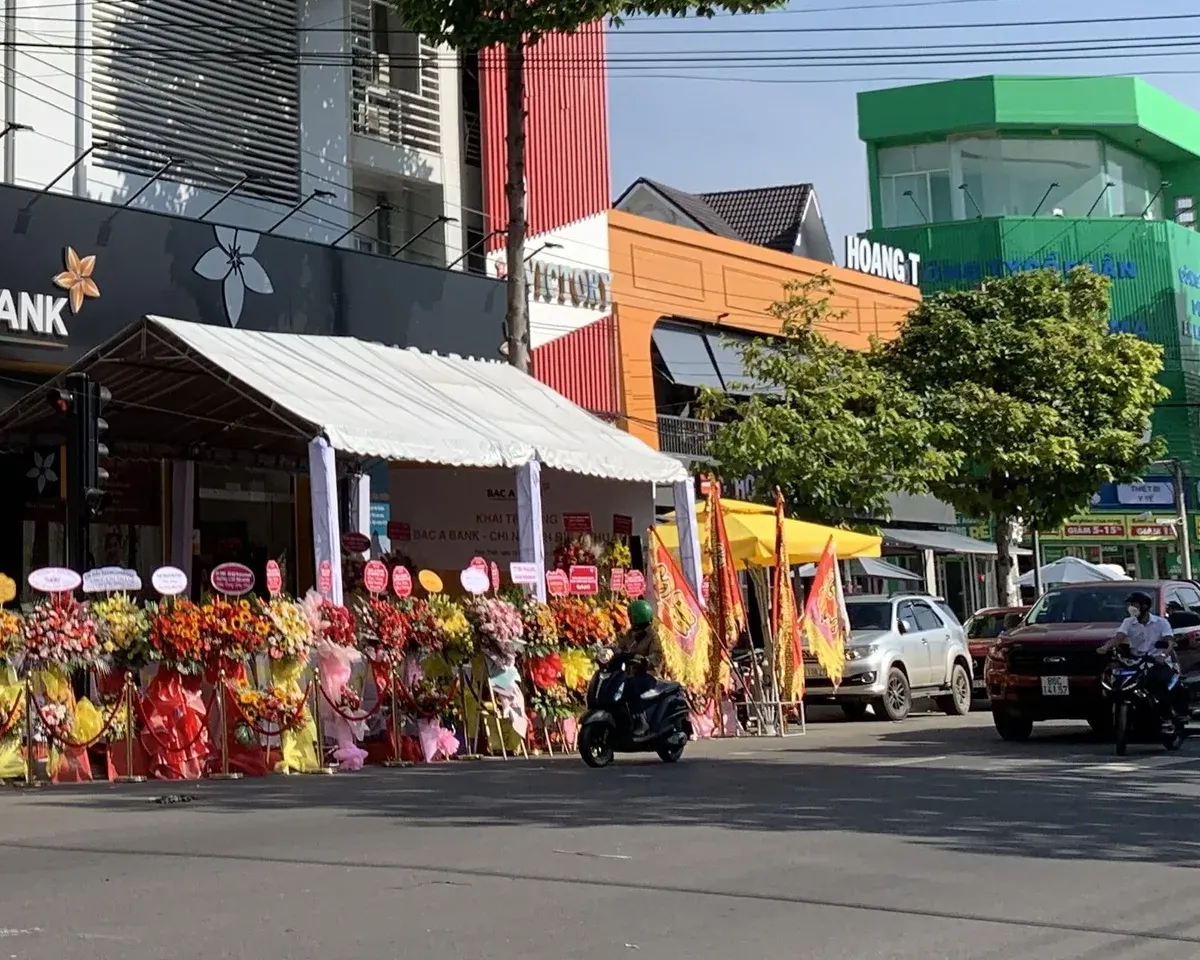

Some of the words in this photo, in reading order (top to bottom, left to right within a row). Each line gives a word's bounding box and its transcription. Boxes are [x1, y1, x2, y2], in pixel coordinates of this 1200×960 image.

[845, 235, 905, 283] HOANG
[487, 489, 506, 498] BAC
[507, 489, 515, 497] A
[476, 514, 502, 524] KHAI
[413, 530, 436, 540] BAC
[439, 530, 446, 540] A
[449, 530, 480, 541] BANK
[489, 531, 508, 541] CHI
